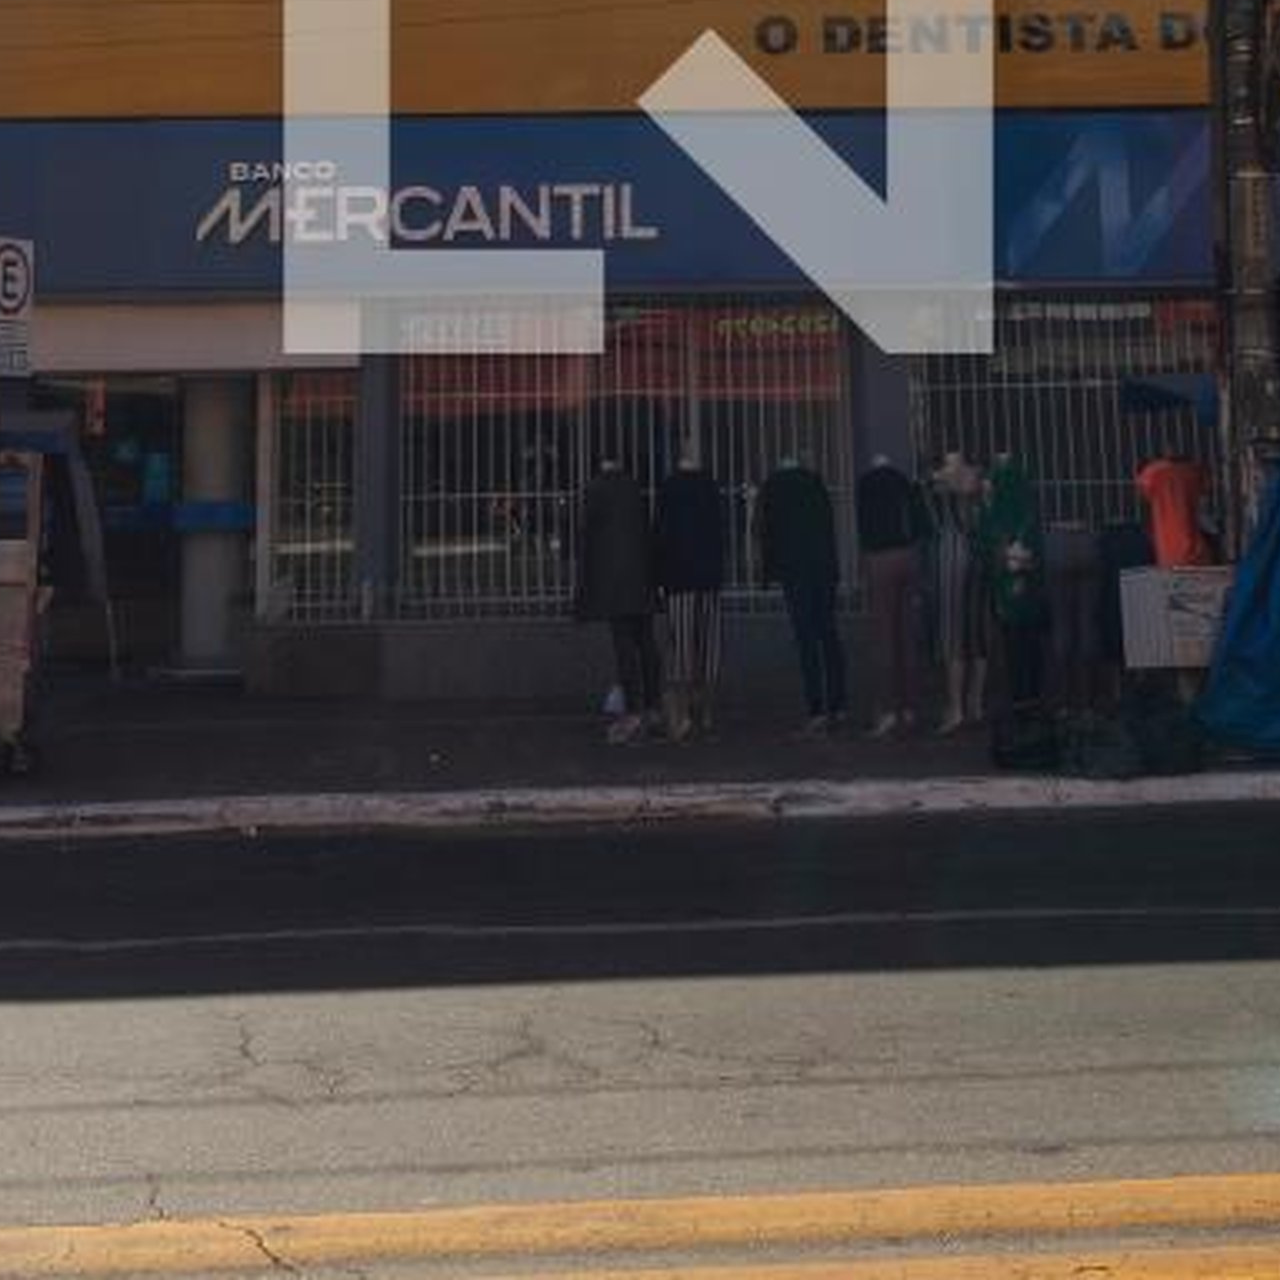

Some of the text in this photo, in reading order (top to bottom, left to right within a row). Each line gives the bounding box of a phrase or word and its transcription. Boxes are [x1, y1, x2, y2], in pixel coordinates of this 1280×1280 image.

[756, 16, 797, 54] O
[823, 11, 1138, 54] DENTISTA
[1161, 13, 1210, 49] D
[228, 161, 337, 182] BANCO
[195, 182, 658, 243] MERCANTIL
[2, 258, 18, 300] E
